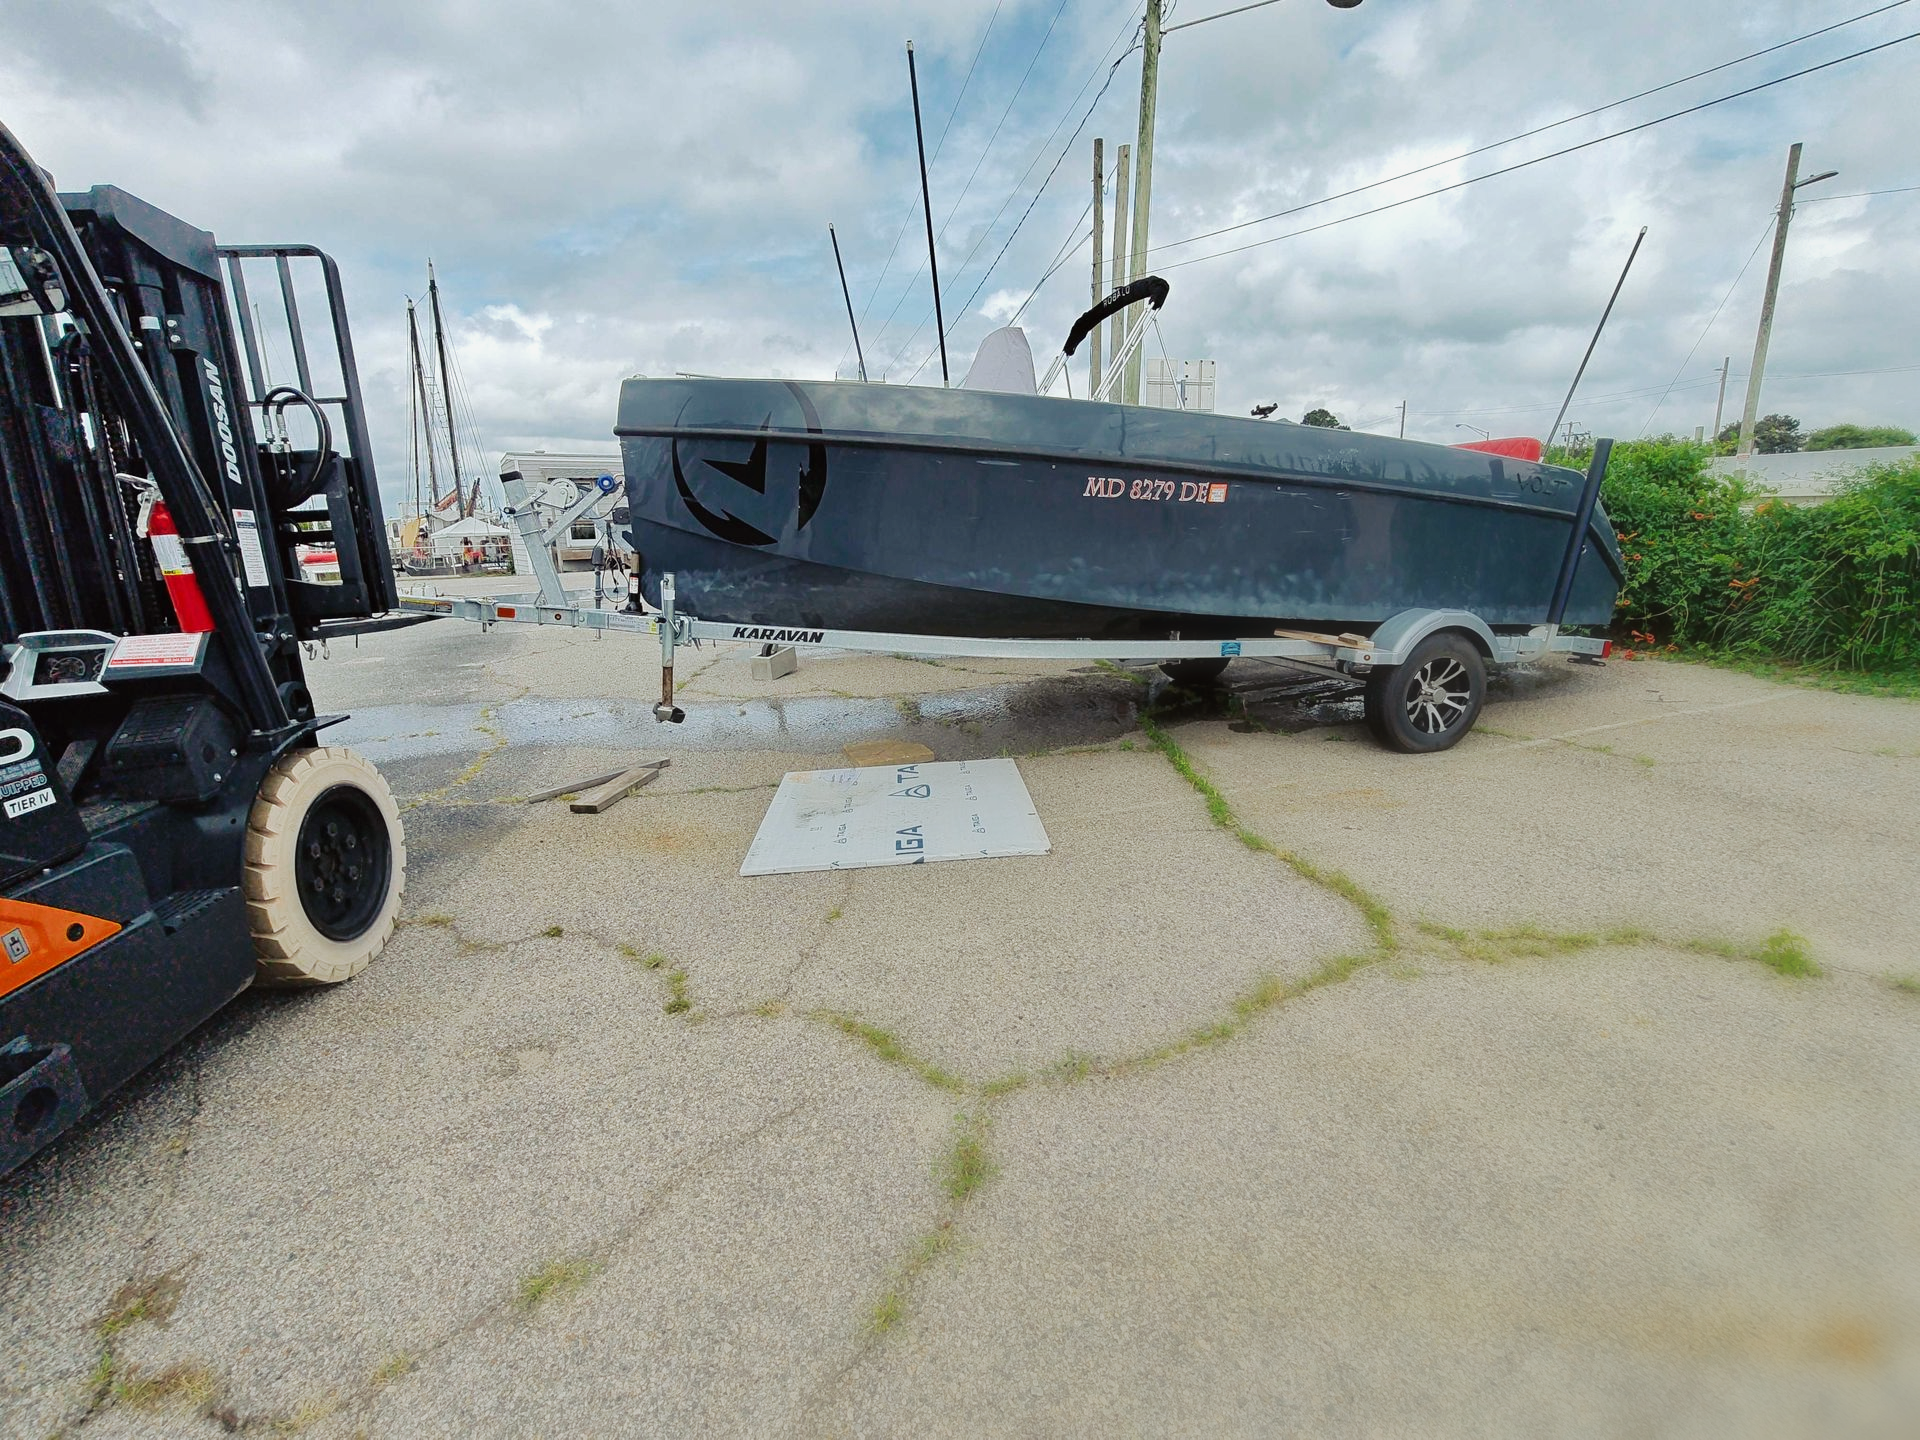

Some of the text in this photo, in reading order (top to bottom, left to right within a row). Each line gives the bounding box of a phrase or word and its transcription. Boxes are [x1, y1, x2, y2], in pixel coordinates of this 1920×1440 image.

[1103, 285, 1130, 308] ROBALO
[203, 357, 242, 485] DOOSAN
[1083, 476, 1125, 498] MD
[1129, 478, 1176, 501] 8279
[1178, 481, 1210, 504] DE
[732, 626, 825, 643] KARAVAN
[0, 773, 48, 799] UIPPED
[9, 791, 50, 814] TIER IV
